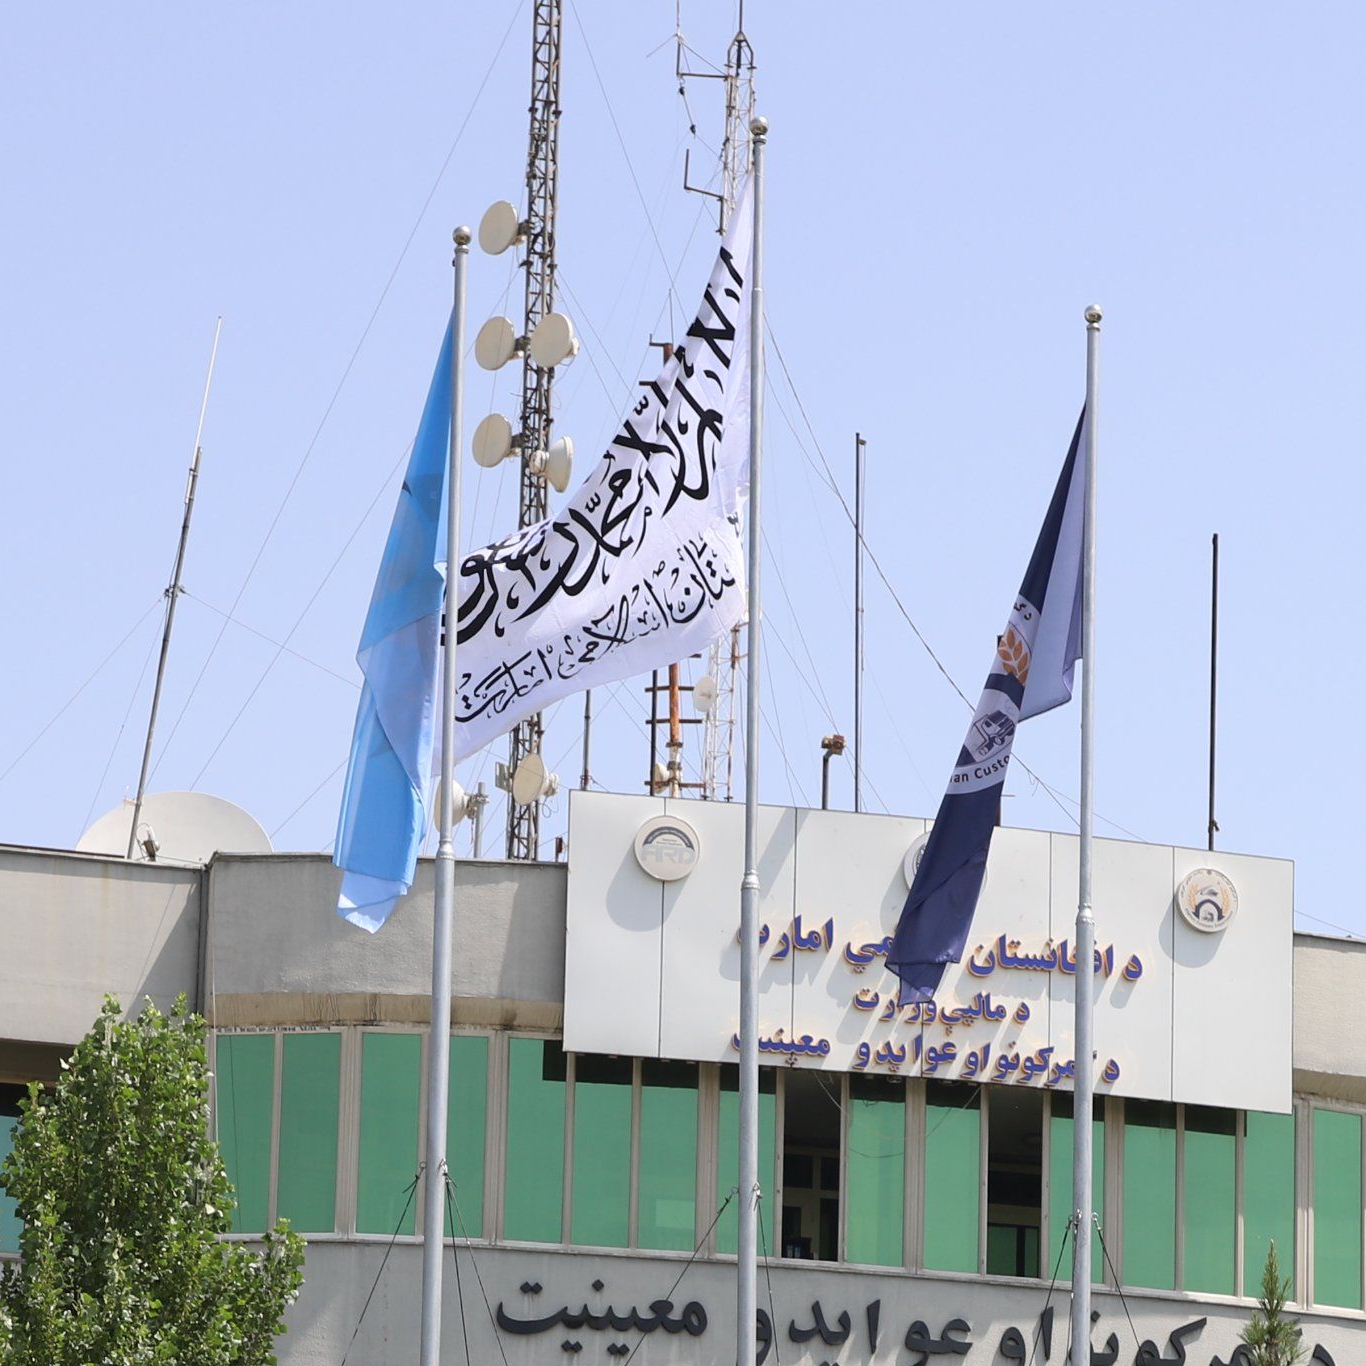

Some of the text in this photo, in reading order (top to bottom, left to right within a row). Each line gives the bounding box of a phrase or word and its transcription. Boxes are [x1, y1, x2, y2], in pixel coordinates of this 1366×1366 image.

[968, 933, 1114, 977] افانستان
[1123, 954, 1143, 980] د
[991, 1041, 1097, 1086] مرکونو
